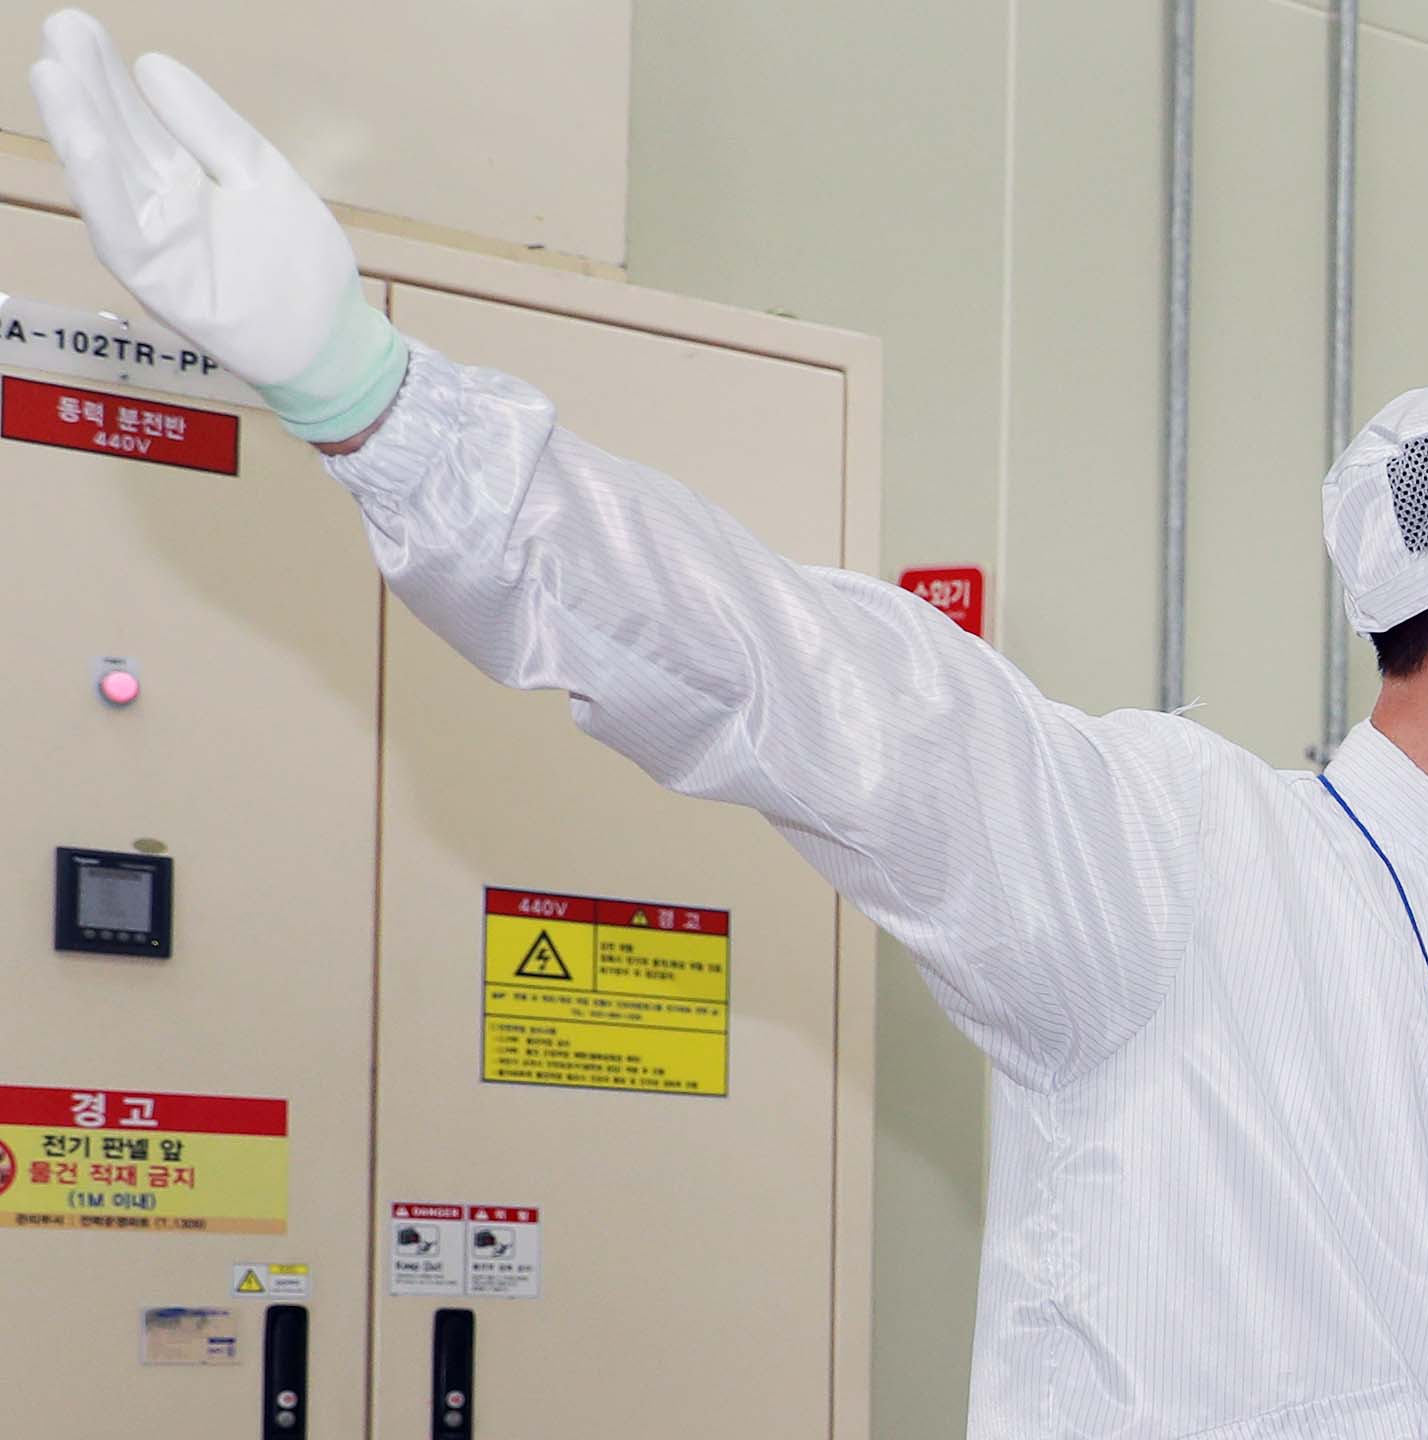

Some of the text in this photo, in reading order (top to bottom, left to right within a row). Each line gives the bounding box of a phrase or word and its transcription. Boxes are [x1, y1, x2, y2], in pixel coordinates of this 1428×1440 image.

[57, 395, 187, 441] 동력 분전반
[92, 430, 152, 455] 440V
[518, 898, 568, 916] 440V
[42, 1135, 183, 1162] 전기 판넬 앞
[29, 1161, 78, 1184] 물건
[90, 1163, 138, 1186] 적재
[148, 1165, 195, 1189] 금지
[69, 1191, 157, 1210] (1M 이내)
